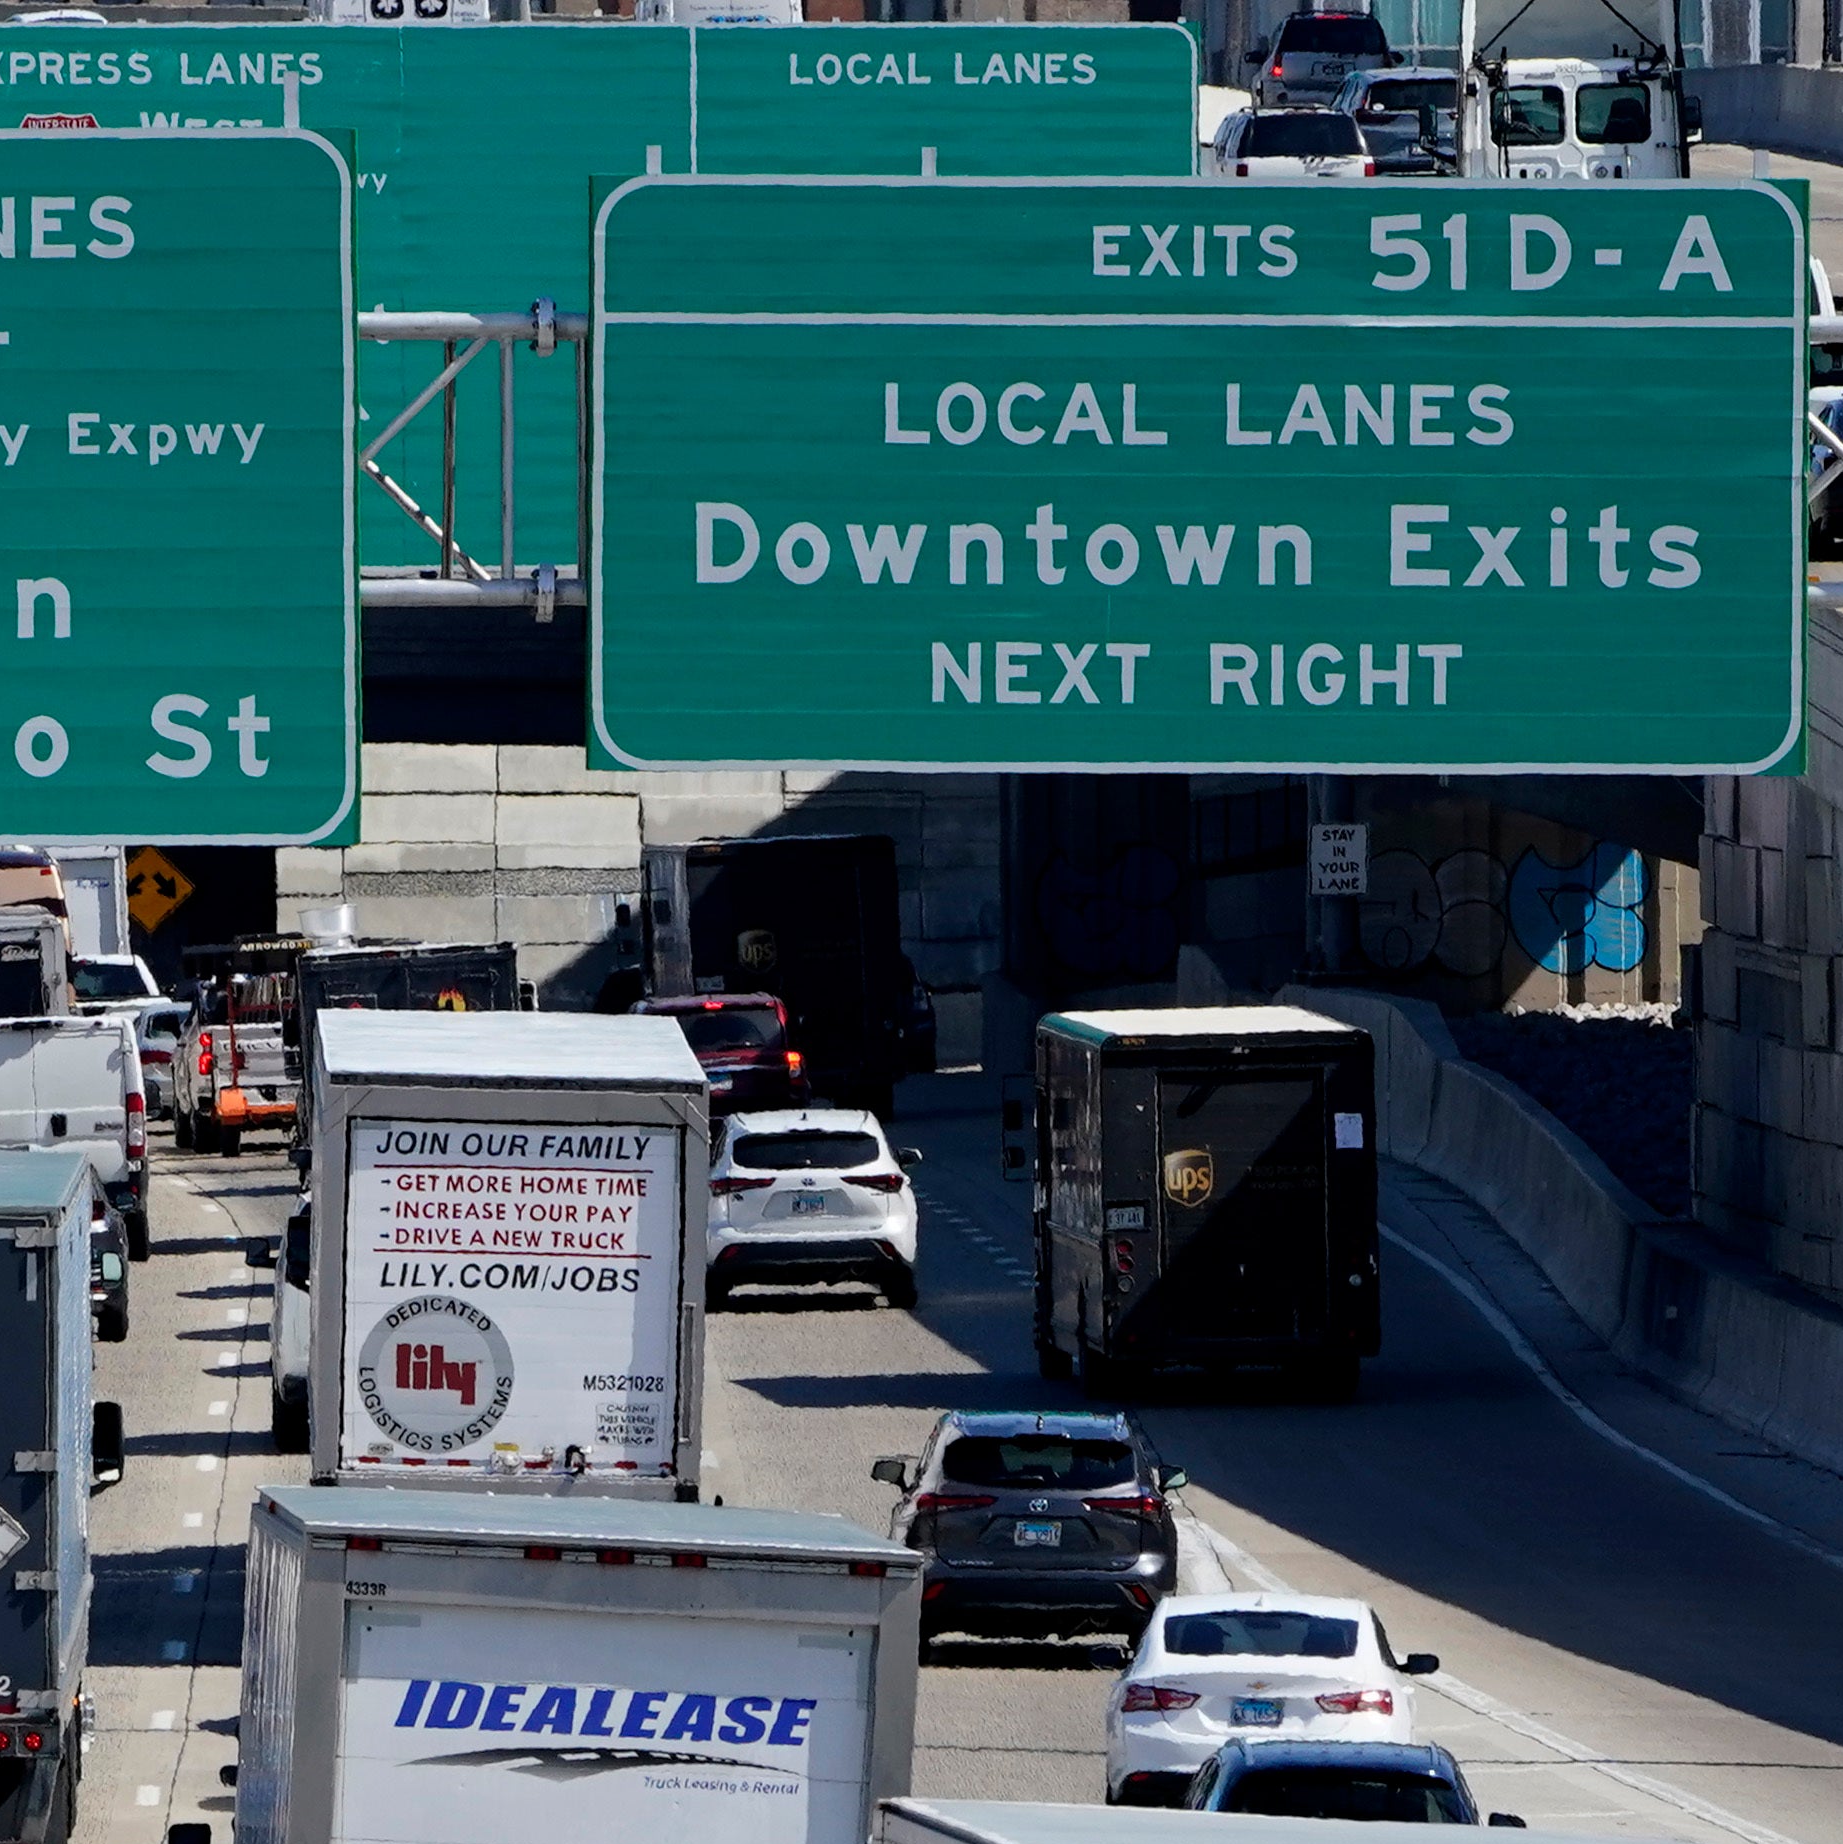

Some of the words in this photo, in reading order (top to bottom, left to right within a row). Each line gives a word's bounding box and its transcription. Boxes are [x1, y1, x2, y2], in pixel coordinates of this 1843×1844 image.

[180, 52, 324, 86] LANES
[789, 51, 933, 86] LOCAL
[955, 51, 1098, 87] LANES
[1091, 223, 1300, 280] EXITS
[883, 381, 1168, 448] LOCAL
[1224, 382, 1517, 448] LANES
[67, 411, 266, 467] Expwy
[694, 499, 1316, 588] Downtown
[1388, 502, 1704, 590] Exits
[929, 641, 1152, 707] NEXT
[1208, 642, 1465, 708] RIGHT
[145, 692, 272, 781] St
[1322, 828, 1356, 842] STAY
[1333, 845, 1346, 857] IN
[1318, 861, 1360, 873] YOUR
[1318, 877, 1360, 891] LANE
[376, 1131, 450, 1155] JOIN
[461, 1132, 530, 1157] OUR
[539, 1135, 651, 1161] FAMILY
[396, 1174, 440, 1192] GET
[446, 1175, 512, 1194] MORE
[520, 1176, 587, 1195] HOME
[596, 1178, 648, 1197] TIME
[1167, 1167, 1211, 1200] ups
[395, 1201, 506, 1220] INCREASE
[514, 1203, 579, 1223] YOUR
[586, 1205, 633, 1223] PAY
[395, 1228, 462, 1245] DRIVE
[469, 1230, 486, 1246] A
[493, 1230, 543, 1248] NEW
[551, 1231, 625, 1250] TRUCK
[379, 1262, 641, 1293] LILY.COM/JOBS
[385, 1298, 492, 1333] DEDICATED
[582, 1374, 665, 1393] M5321028
[358, 1366, 434, 1451] LOGISTICS
[440, 1375, 513, 1451] SYSTEMS
[345, 1581, 387, 1597] 4333R
[394, 1679, 818, 1748] IDEALEASE
[643, 1775, 682, 1791] Truck
[684, 1777, 737, 1796] Leasing
[739, 1781, 750, 1794] &
[752, 1781, 800, 1796] Rental
